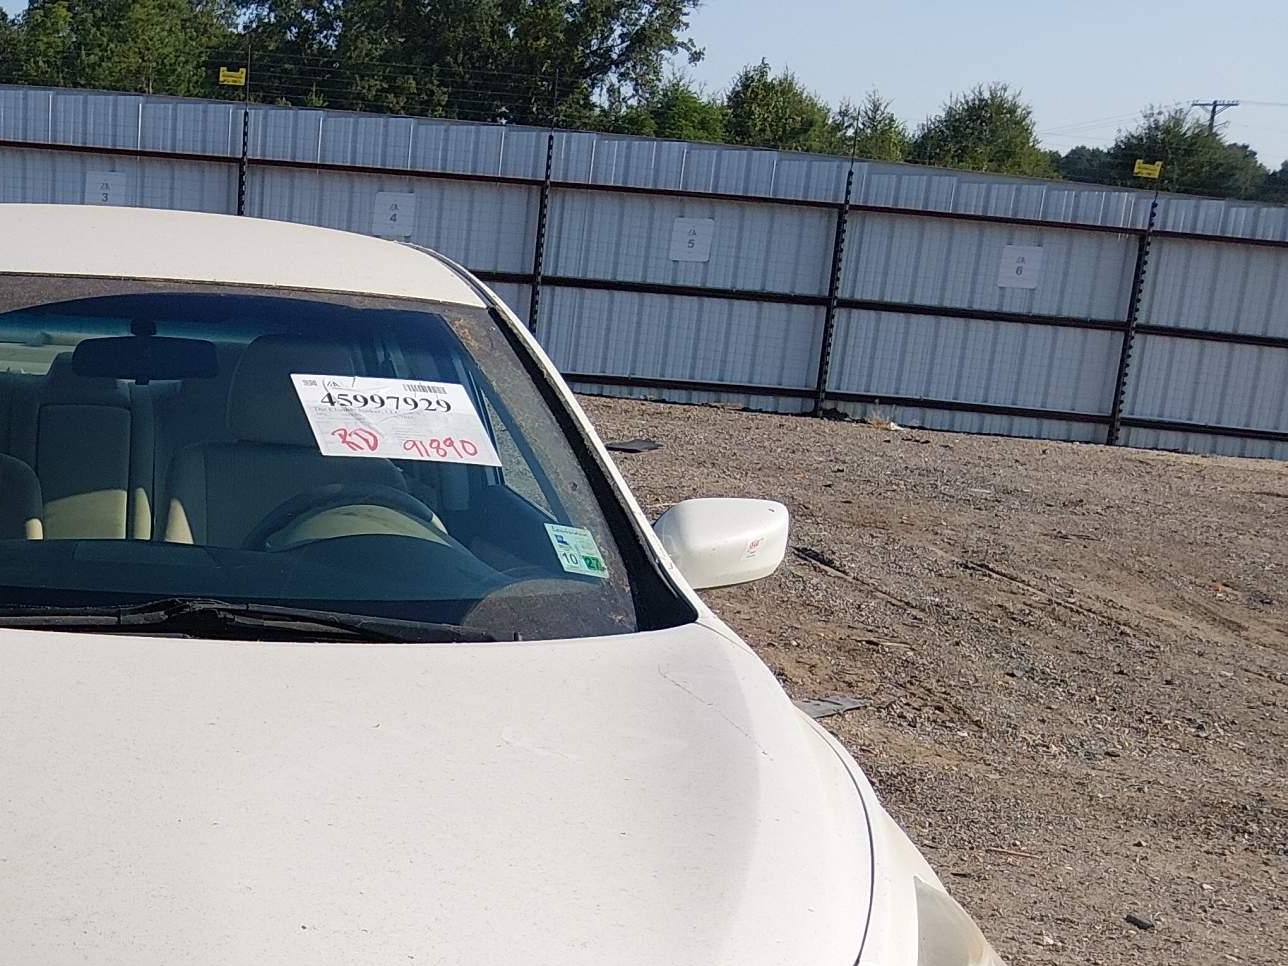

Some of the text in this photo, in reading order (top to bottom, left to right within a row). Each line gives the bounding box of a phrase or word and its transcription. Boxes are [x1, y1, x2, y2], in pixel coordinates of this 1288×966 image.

[102, 192, 109, 202] 3
[687, 239, 696, 249] 5
[1015, 265, 1023, 276] 6
[320, 391, 452, 413] 45997929
[402, 436, 479, 459] 91890
[562, 551, 579, 565] 10
